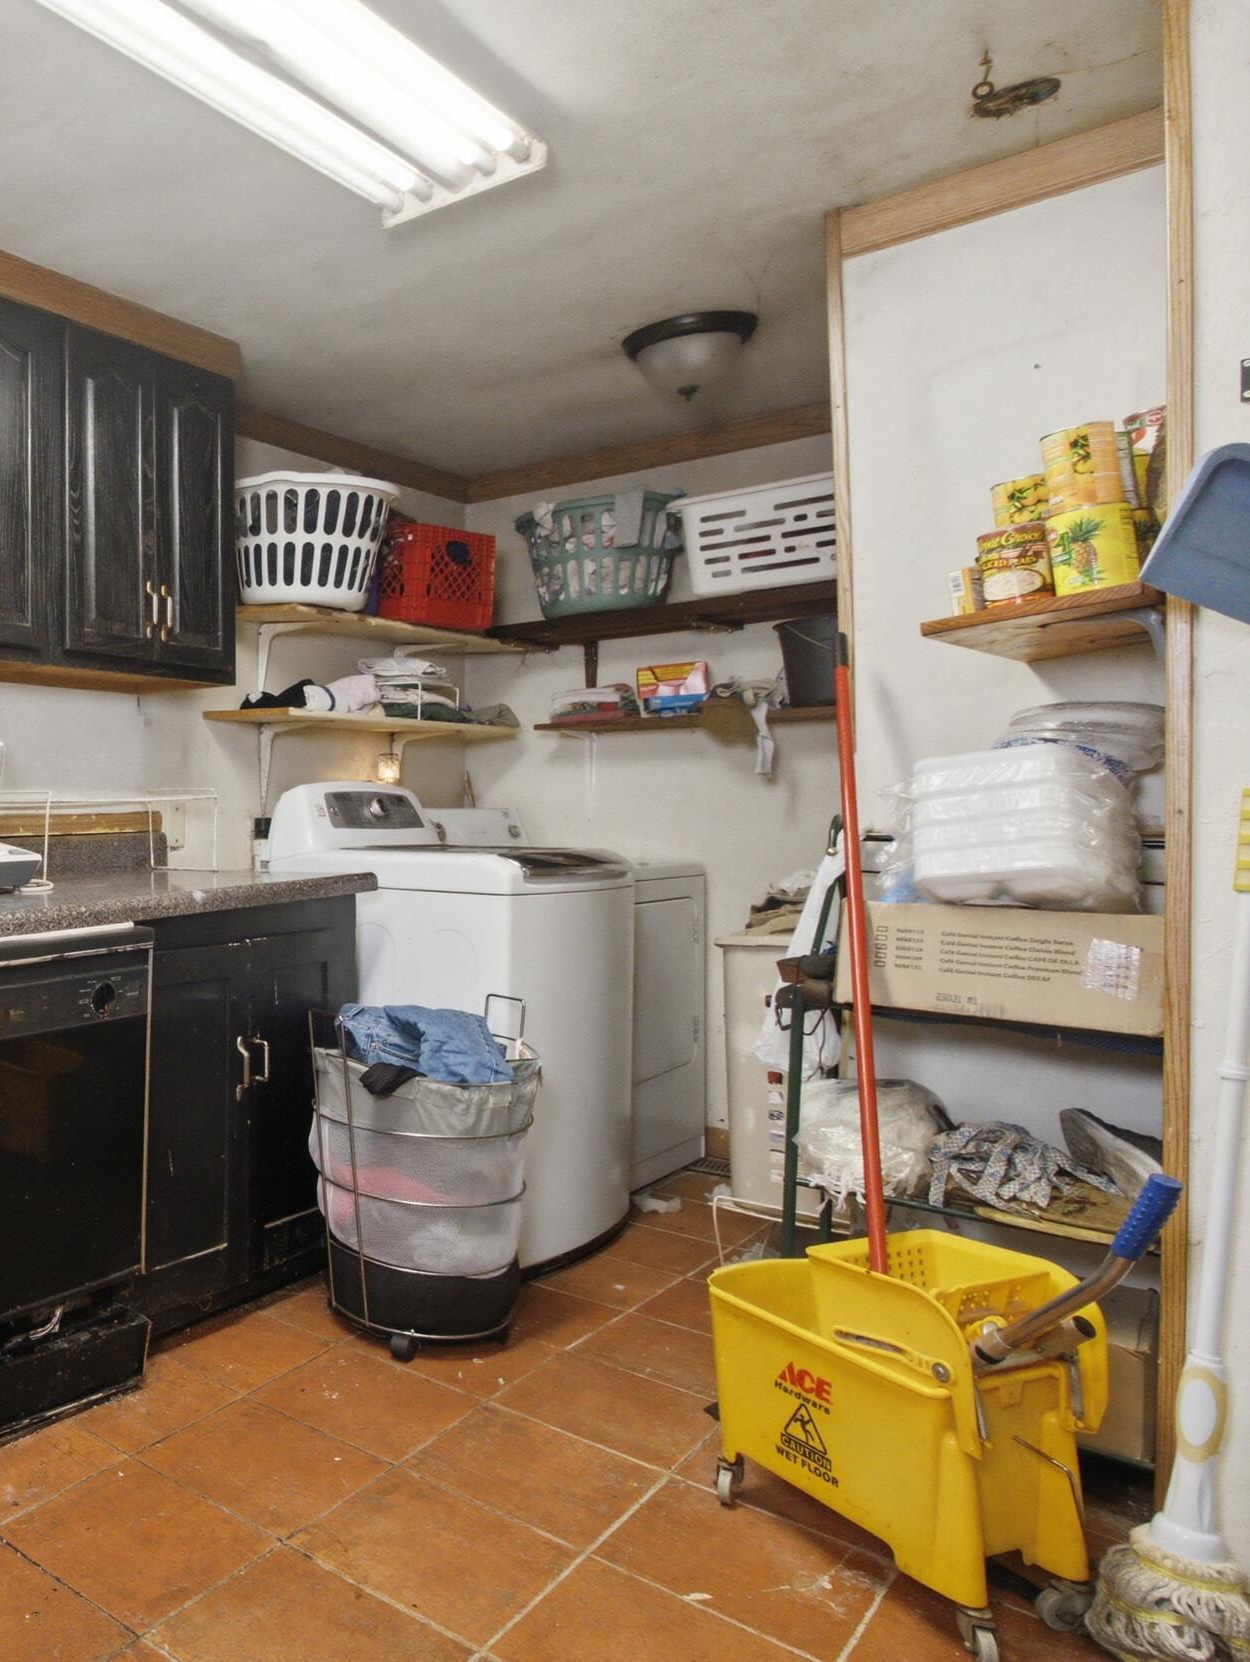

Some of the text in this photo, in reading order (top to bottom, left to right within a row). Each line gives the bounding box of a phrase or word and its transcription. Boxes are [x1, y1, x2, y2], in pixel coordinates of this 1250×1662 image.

[774, 1379, 830, 1415] Hardware
[777, 1361, 833, 1406] ACE
[775, 1445, 839, 1488] WET FLOOR
[782, 1435, 831, 1471] CAUTION
